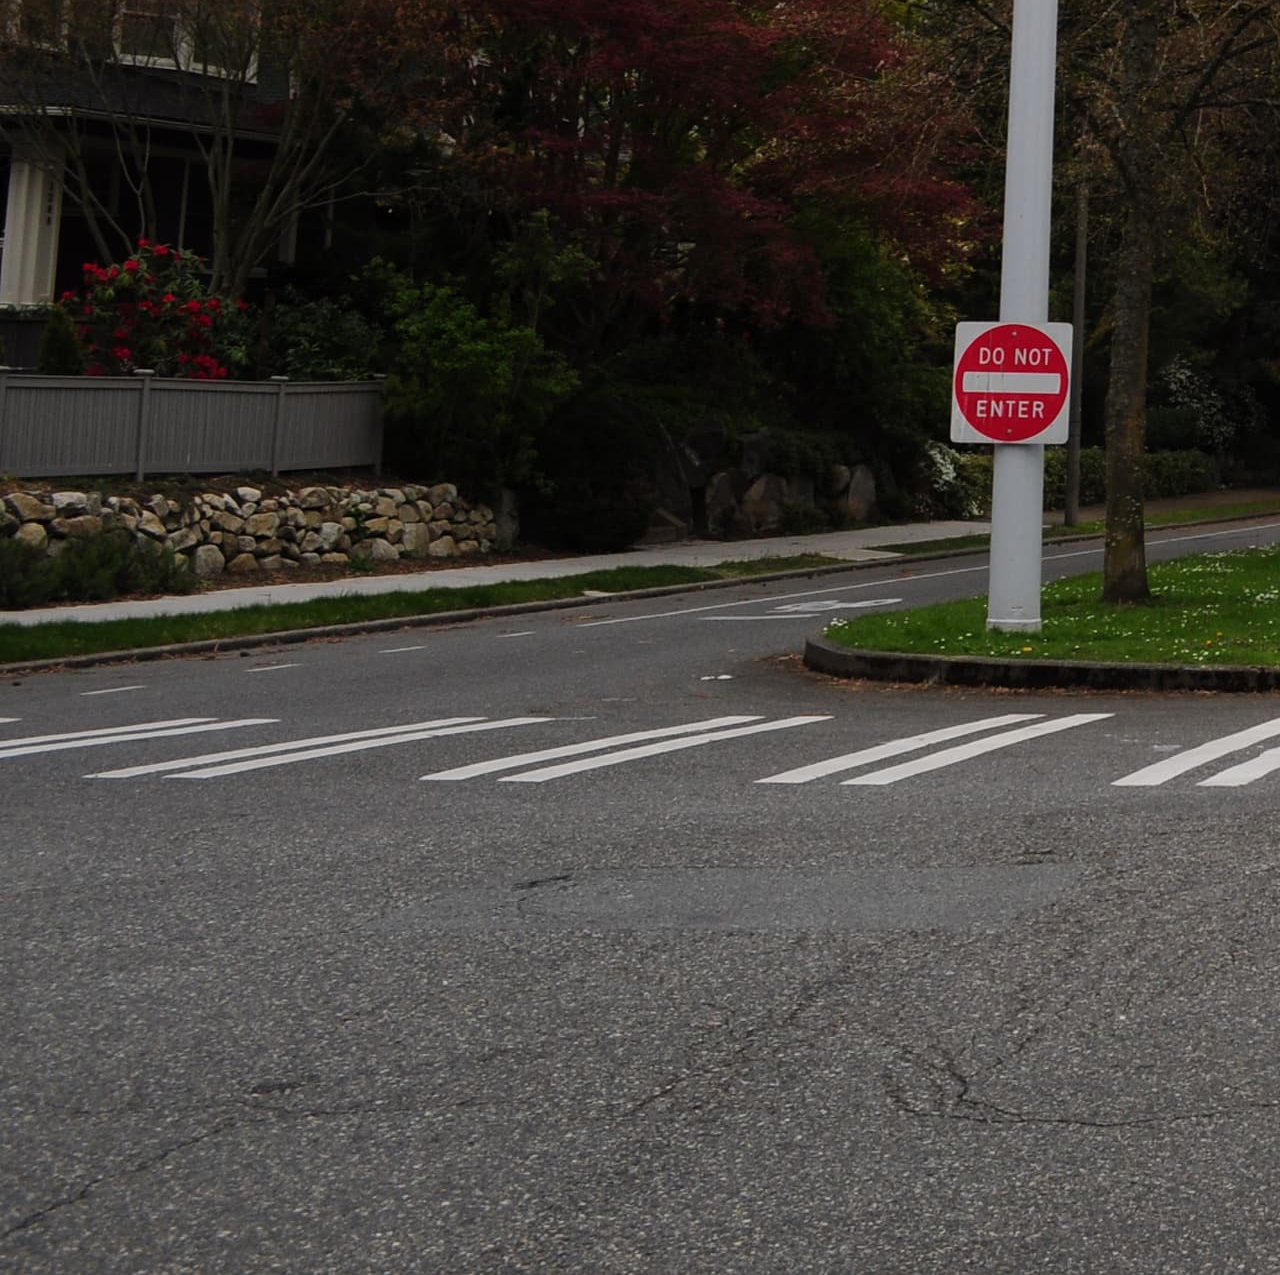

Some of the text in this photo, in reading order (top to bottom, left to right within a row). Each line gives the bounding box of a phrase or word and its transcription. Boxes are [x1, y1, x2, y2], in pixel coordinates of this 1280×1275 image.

[979, 347, 1053, 366] DO NOT
[976, 399, 1045, 419] ENTER
